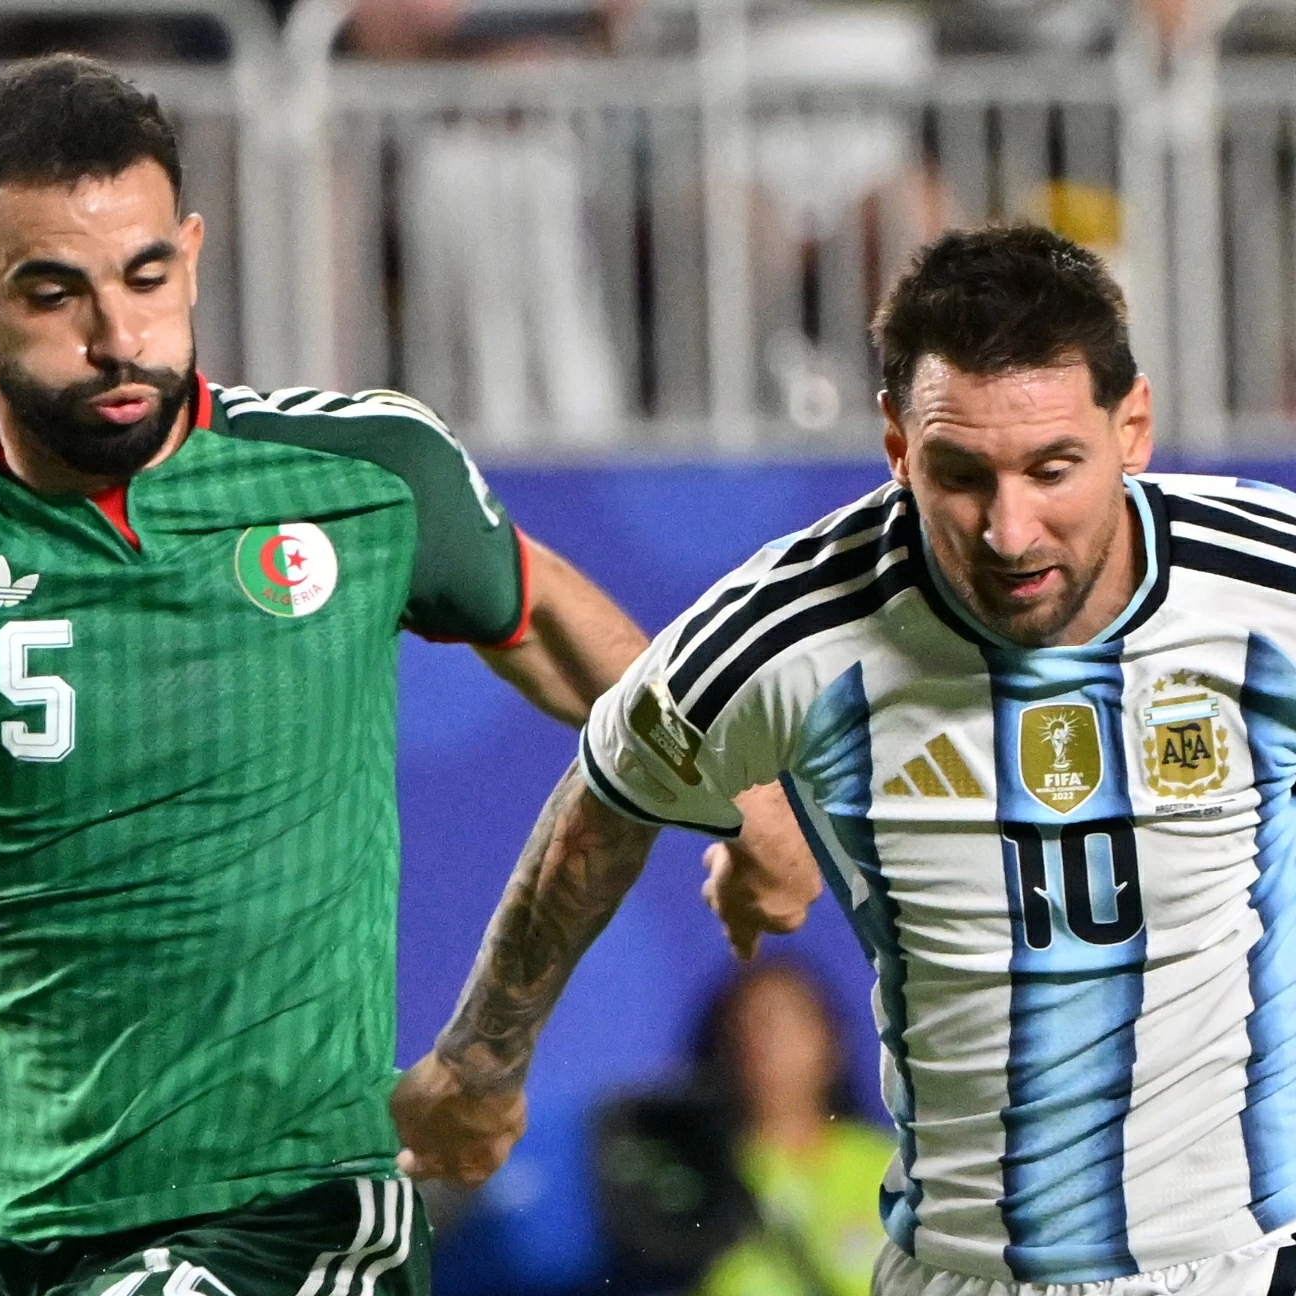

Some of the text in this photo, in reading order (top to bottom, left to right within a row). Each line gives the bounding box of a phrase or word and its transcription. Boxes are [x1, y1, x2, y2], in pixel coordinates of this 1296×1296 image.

[262, 584, 323, 606] ALGERIA
[1161, 722, 1211, 769] AFA
[1044, 772, 1082, 787] FIFA
[1051, 791, 1074, 801] 2022
[1003, 818, 1146, 951] 10
